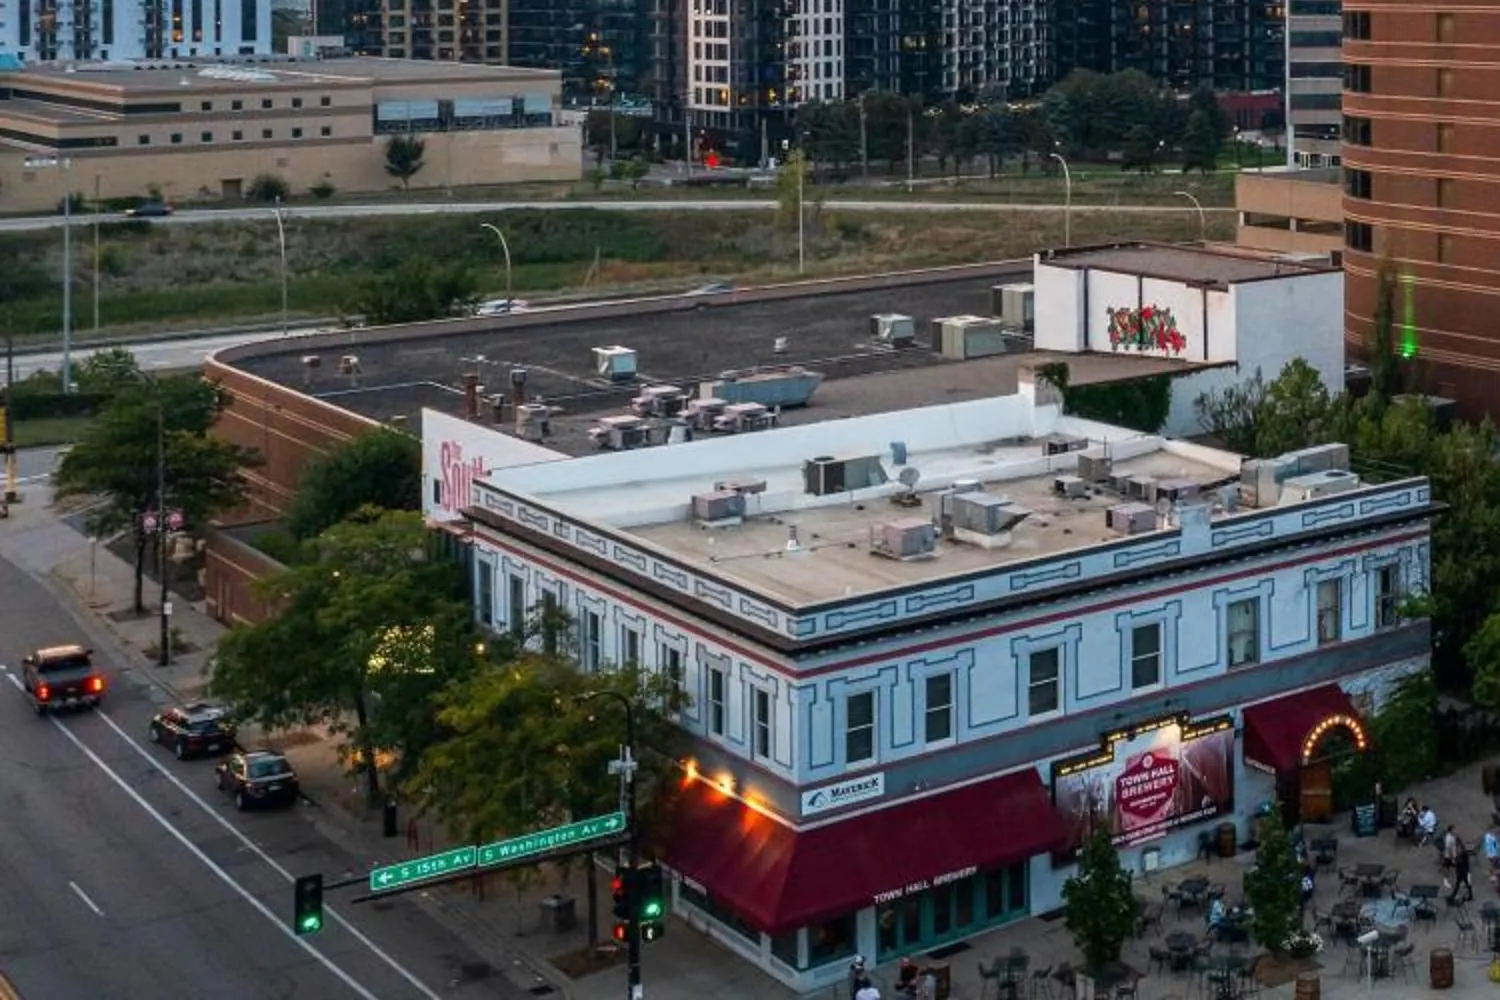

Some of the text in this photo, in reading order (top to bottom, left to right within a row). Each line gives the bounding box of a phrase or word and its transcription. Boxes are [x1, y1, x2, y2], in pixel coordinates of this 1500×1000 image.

[1120, 764, 1175, 787] TOWN HALL
[1121, 774, 1174, 799] BREWERY
[485, 823, 598, 861] S Washington Av
[401, 852, 471, 878] S 15th Av
[873, 887, 903, 904] TOWN
[905, 879, 930, 896] HALL
